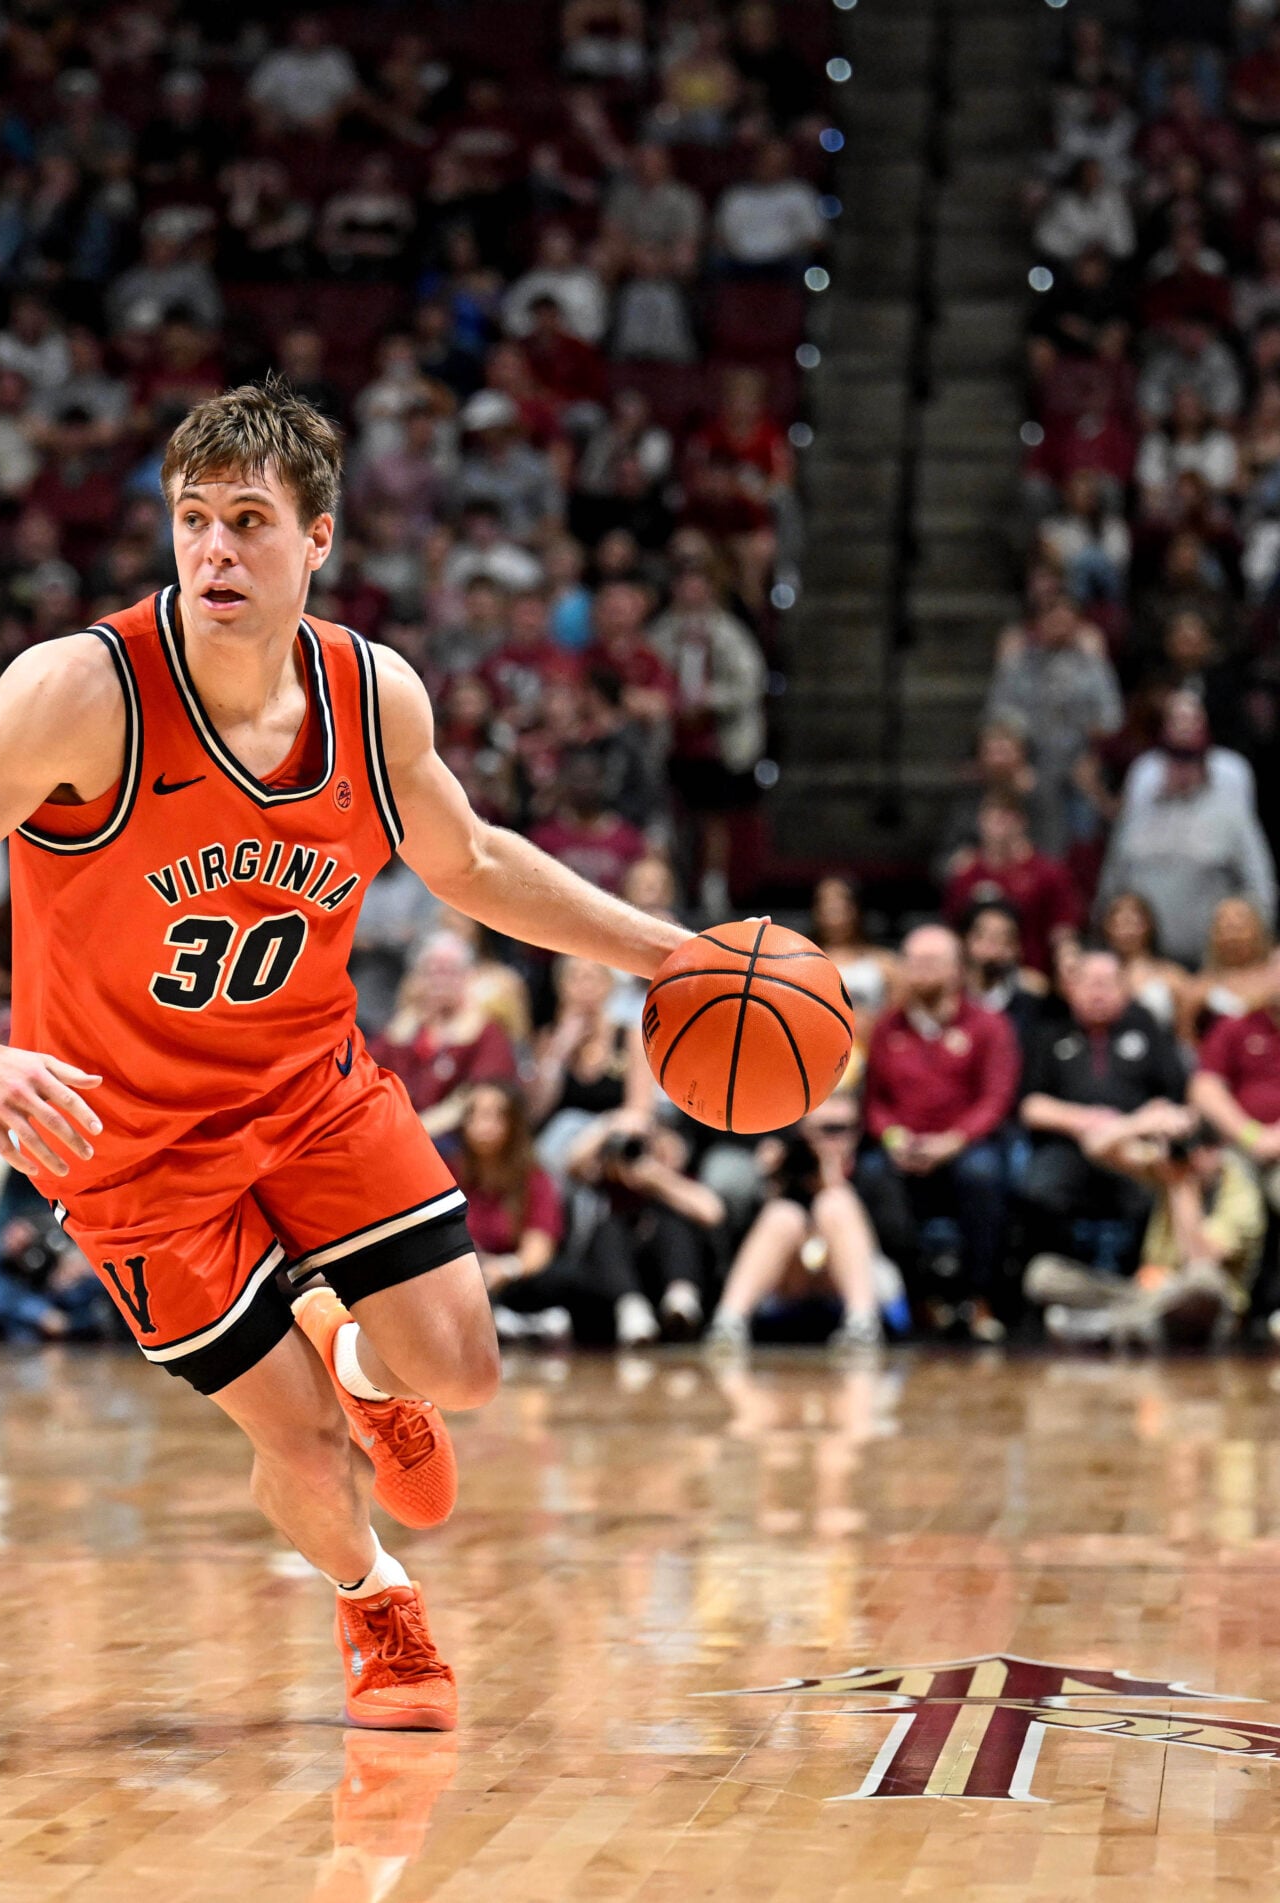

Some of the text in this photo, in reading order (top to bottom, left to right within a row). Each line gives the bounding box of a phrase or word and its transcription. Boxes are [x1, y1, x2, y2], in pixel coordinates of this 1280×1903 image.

[144, 838, 361, 912] VIRGINIA
[148, 909, 308, 1012] 30
[102, 1255, 158, 1335] V
